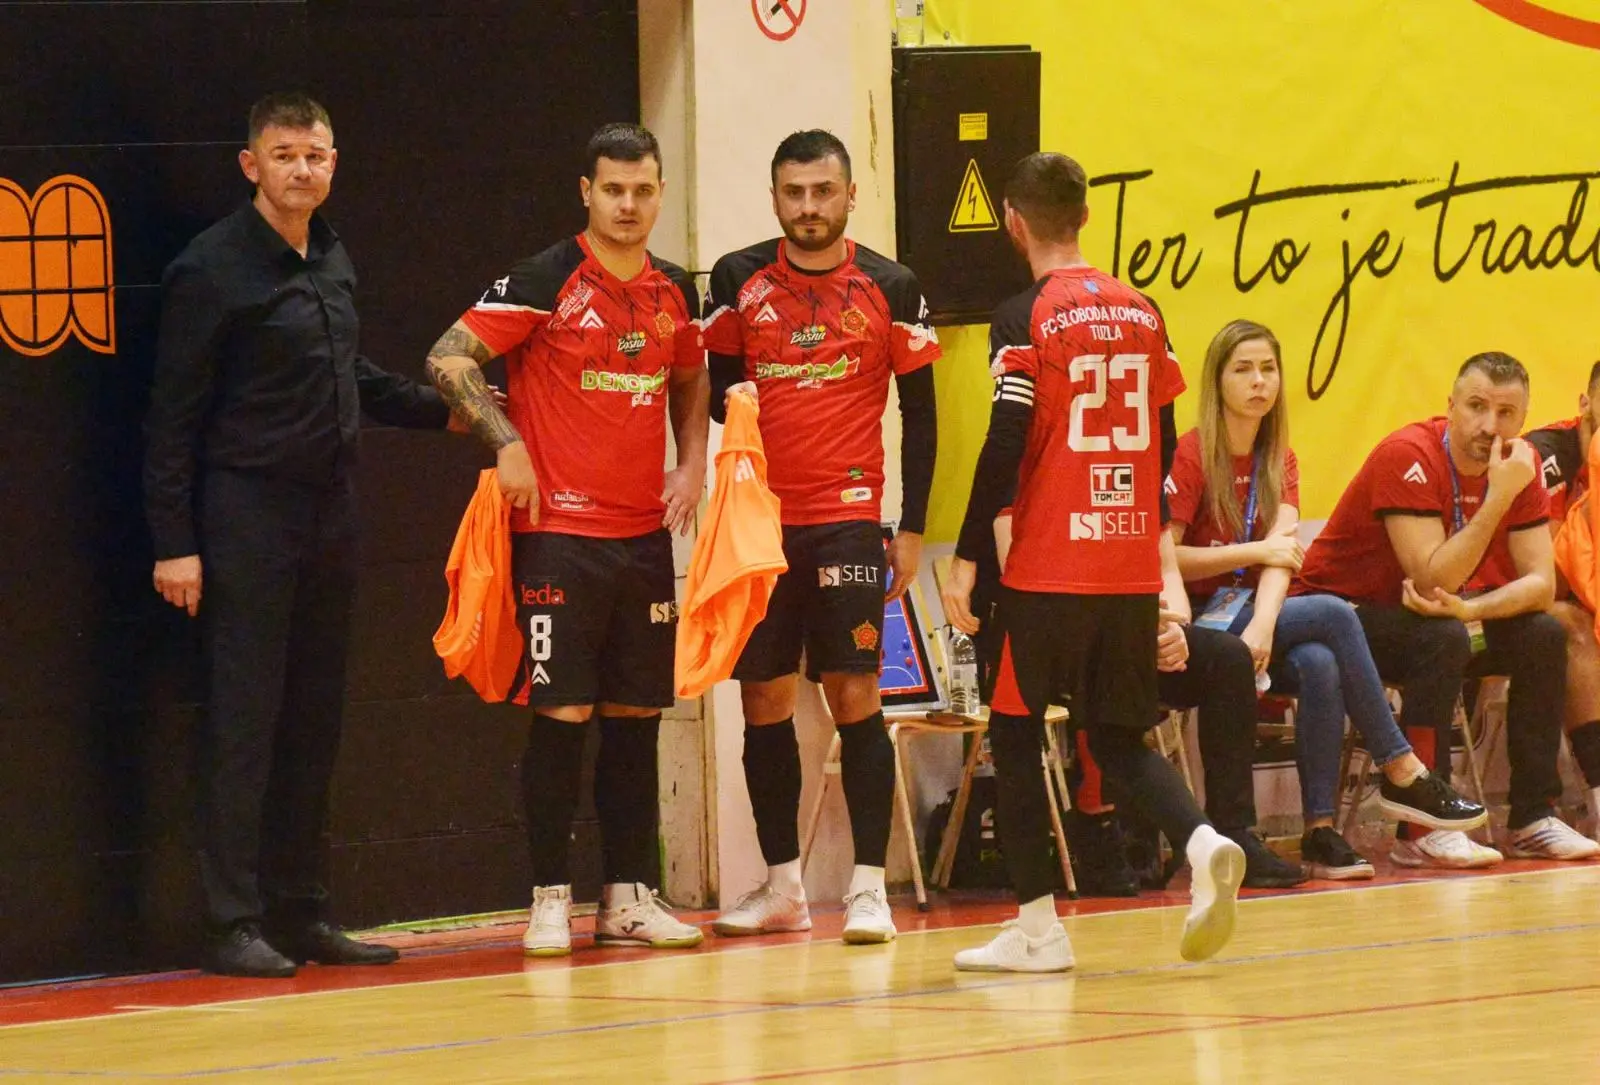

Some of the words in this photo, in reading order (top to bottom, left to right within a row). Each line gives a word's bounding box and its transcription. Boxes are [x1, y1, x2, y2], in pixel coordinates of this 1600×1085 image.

[1088, 169, 1203, 290] Ter
[1306, 208, 1404, 400] je
[1040, 318, 1057, 339] FC
[1056, 306, 1109, 329] SLOBODA
[1109, 306, 1158, 331] KOMPRED
[1089, 324, 1123, 341] TUZLA
[581, 370, 657, 393] DEKOR
[1067, 353, 1151, 452] 23
[1093, 467, 1131, 491] TC
[1094, 493, 1112, 501] TOM
[1113, 493, 1130, 501] CAT
[1105, 511, 1148, 535] SELT
[842, 564, 879, 583] SELT
[530, 614, 552, 661] 8
